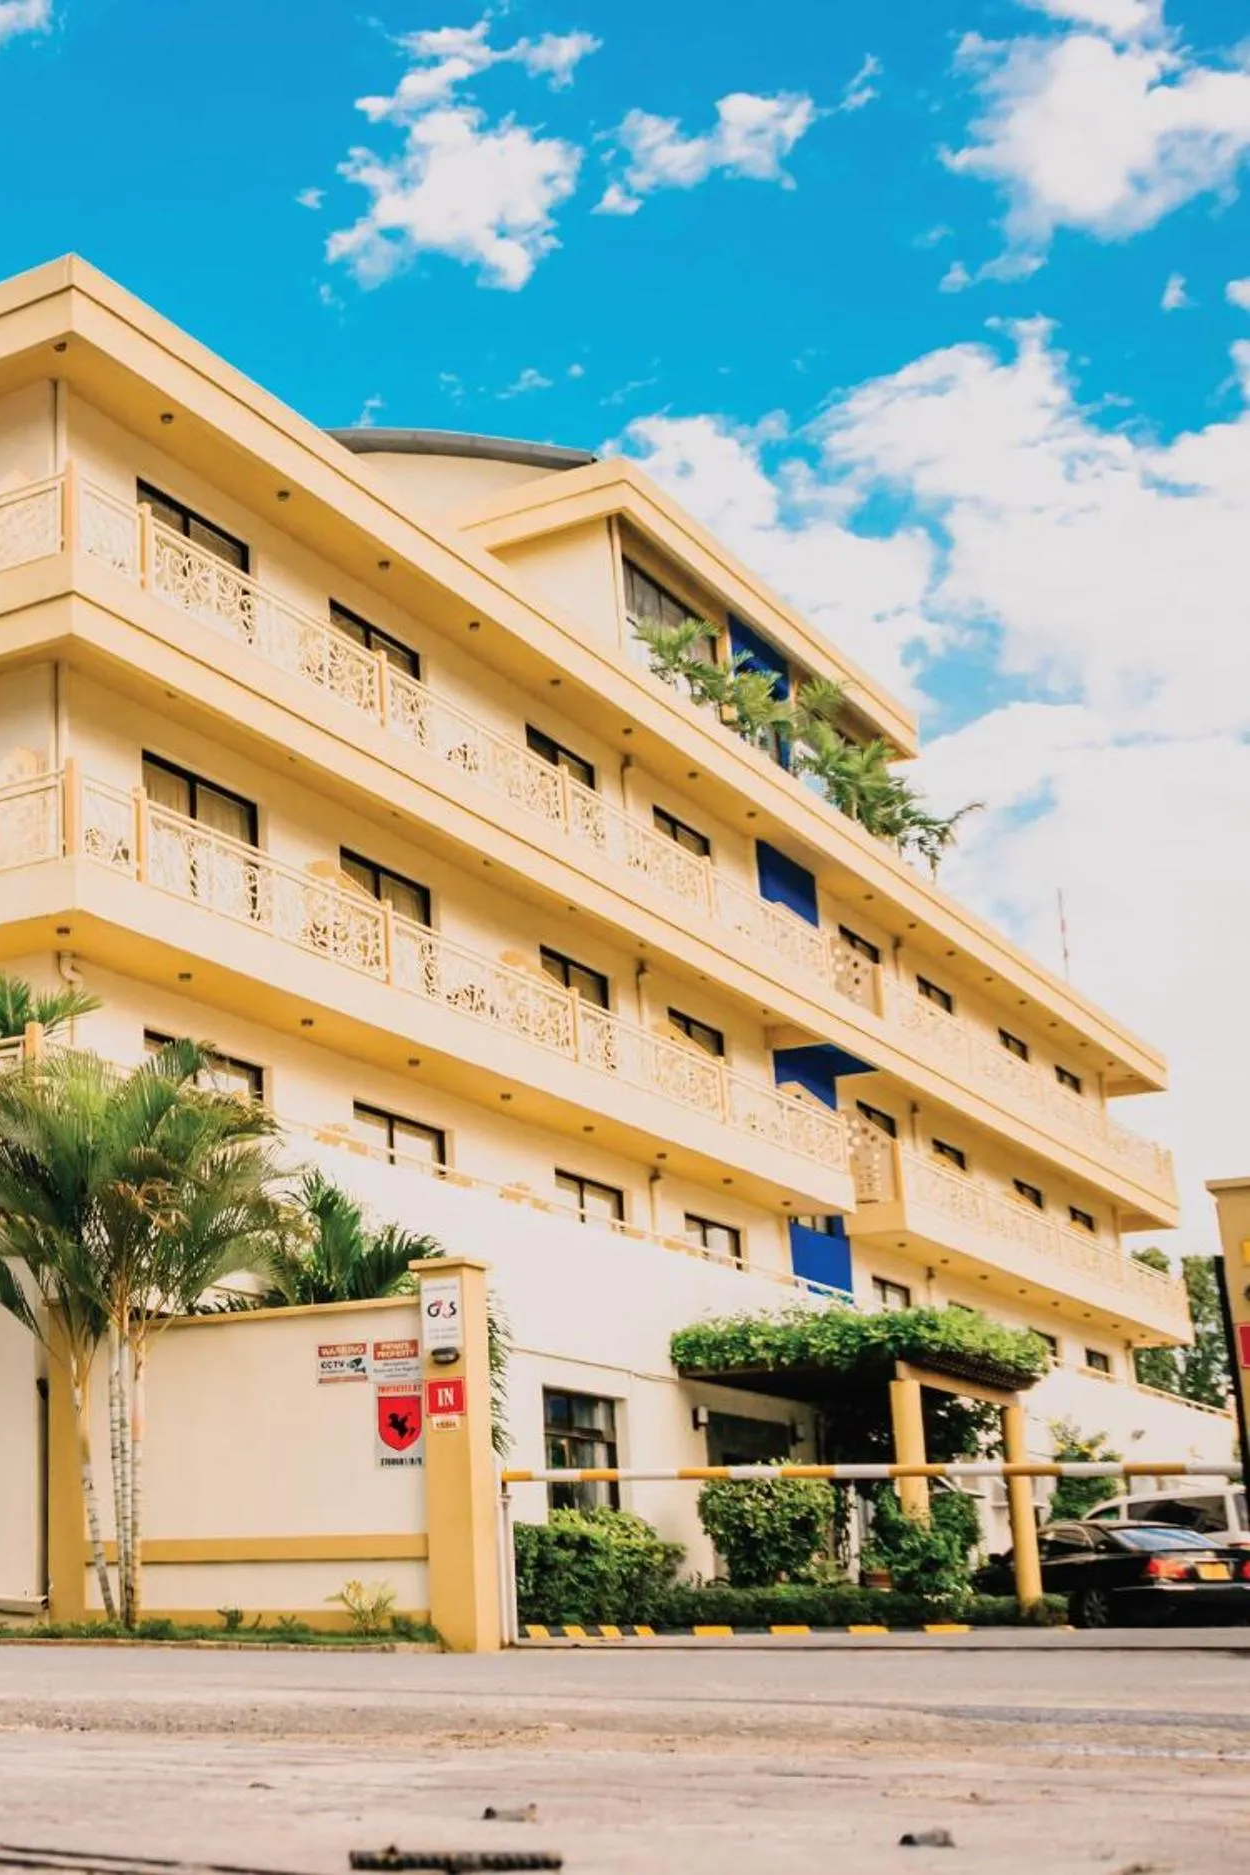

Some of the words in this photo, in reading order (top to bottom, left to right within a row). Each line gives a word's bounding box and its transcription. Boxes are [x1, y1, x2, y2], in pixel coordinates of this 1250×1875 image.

[320, 1345, 365, 1356] WARNING
[320, 1360, 345, 1369] CCTV
[437, 1387, 455, 1407] IN
